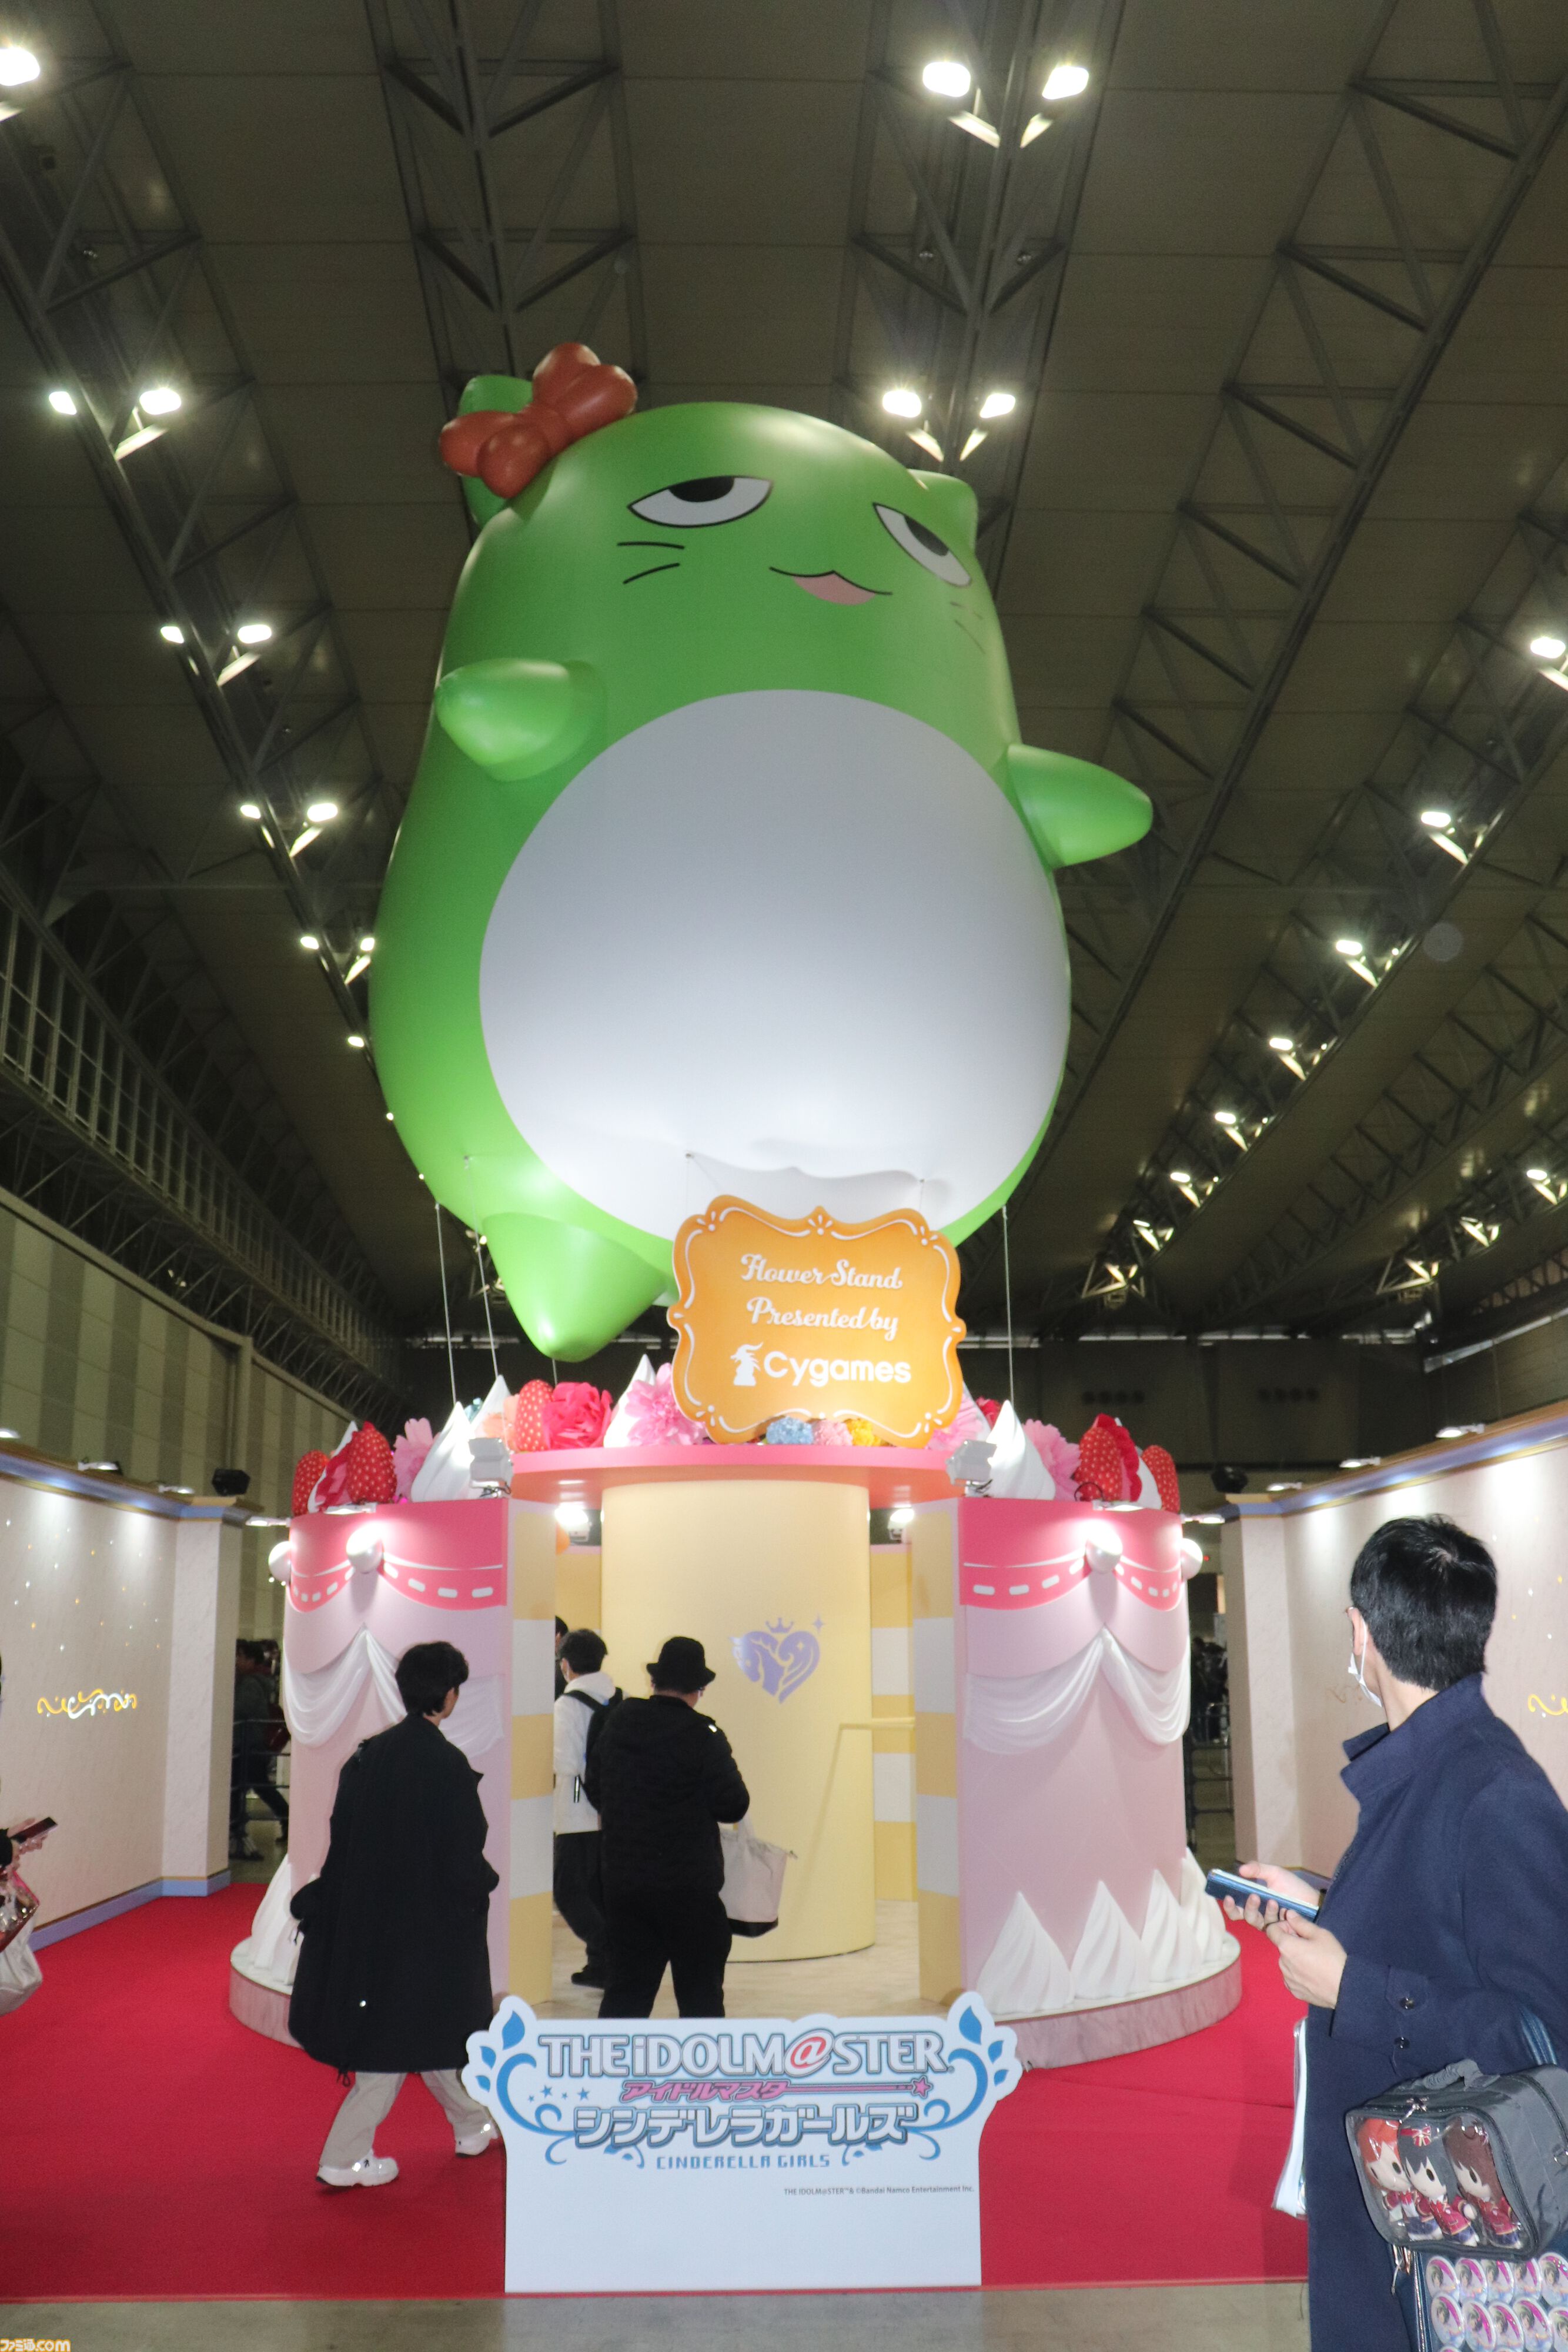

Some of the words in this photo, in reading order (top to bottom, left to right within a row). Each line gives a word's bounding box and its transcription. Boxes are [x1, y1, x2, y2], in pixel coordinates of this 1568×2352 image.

[740, 1253, 825, 1284] Flower
[824, 1259, 903, 1289] Stand
[746, 1297, 870, 1329] Presented
[867, 1307, 898, 1341] by
[764, 1351, 912, 1387] Cygames
[537, 2033, 629, 2077] THE
[574, 2103, 919, 2147] シンデレラガールズ
[656, 2155, 771, 2170] CINDERELLA
[777, 2154, 831, 2169] GIRLS
